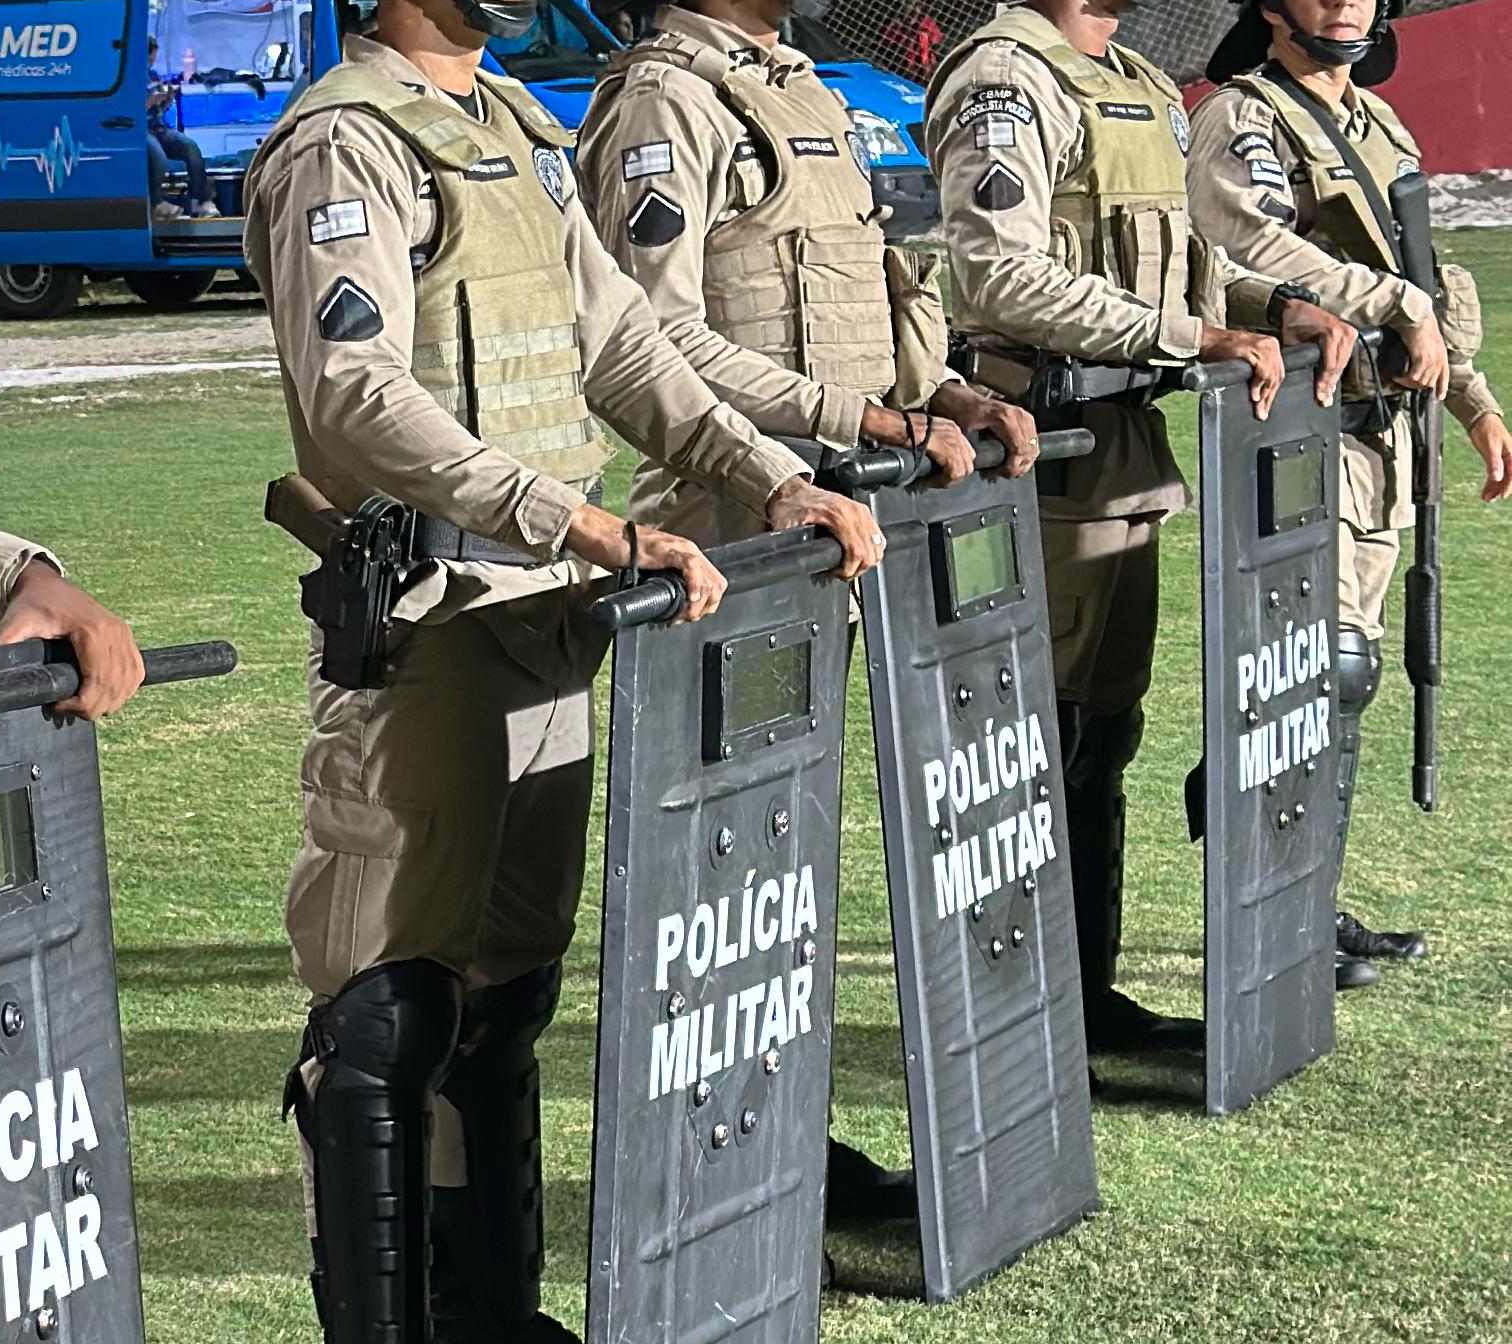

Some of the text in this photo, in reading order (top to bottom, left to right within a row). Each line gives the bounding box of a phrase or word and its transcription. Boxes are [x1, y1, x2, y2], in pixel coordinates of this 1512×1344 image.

[1238, 618, 1331, 713] POLÍCIA
[923, 713, 1049, 827] POLÍCIA
[1239, 696, 1330, 792] MILITAR
[932, 801, 1057, 920] MILITAR
[655, 864, 818, 991] POLÍCIA
[648, 964, 813, 1101] MILITAR
